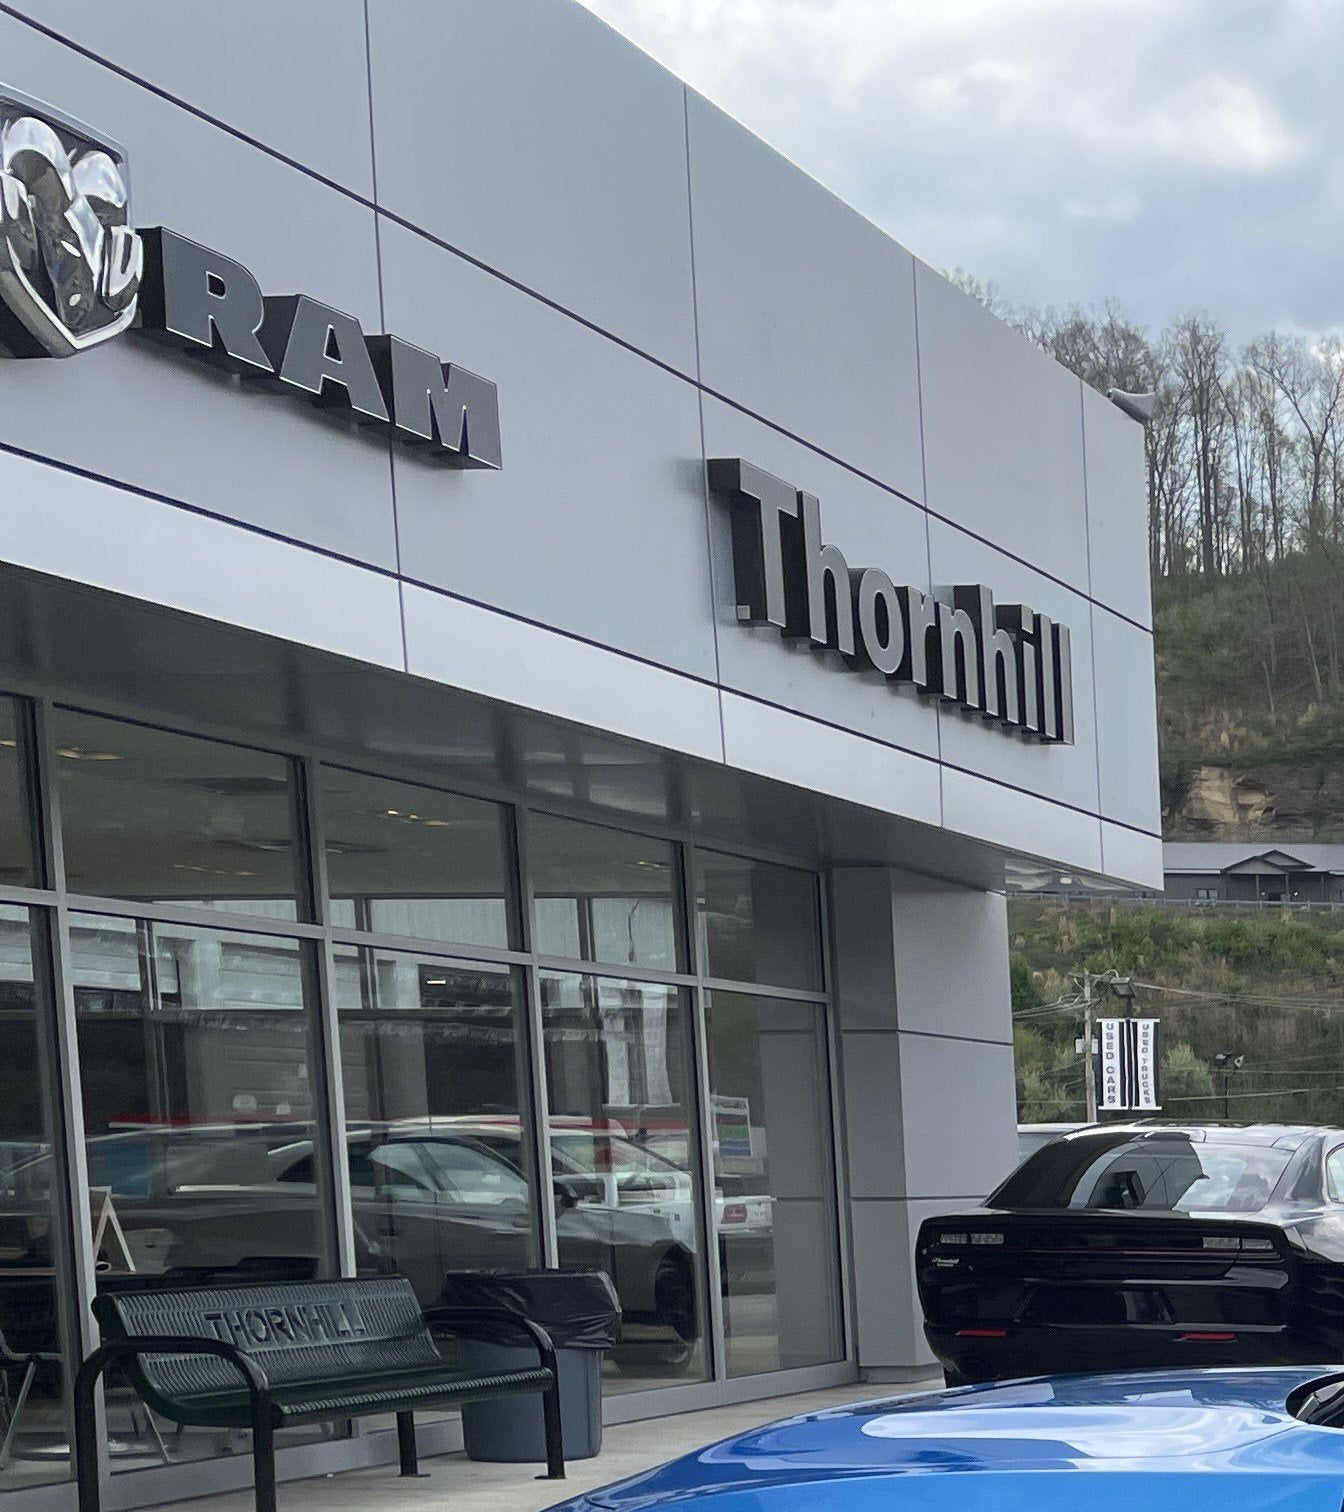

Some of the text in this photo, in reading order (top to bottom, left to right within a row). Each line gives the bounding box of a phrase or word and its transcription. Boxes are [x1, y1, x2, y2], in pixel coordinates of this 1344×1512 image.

[150, 226, 502, 470] RAM
[710, 458, 1074, 745] Thornhill
[1106, 1022, 1116, 1104] USED CARS
[203, 1303, 367, 1346] THORNHILL
